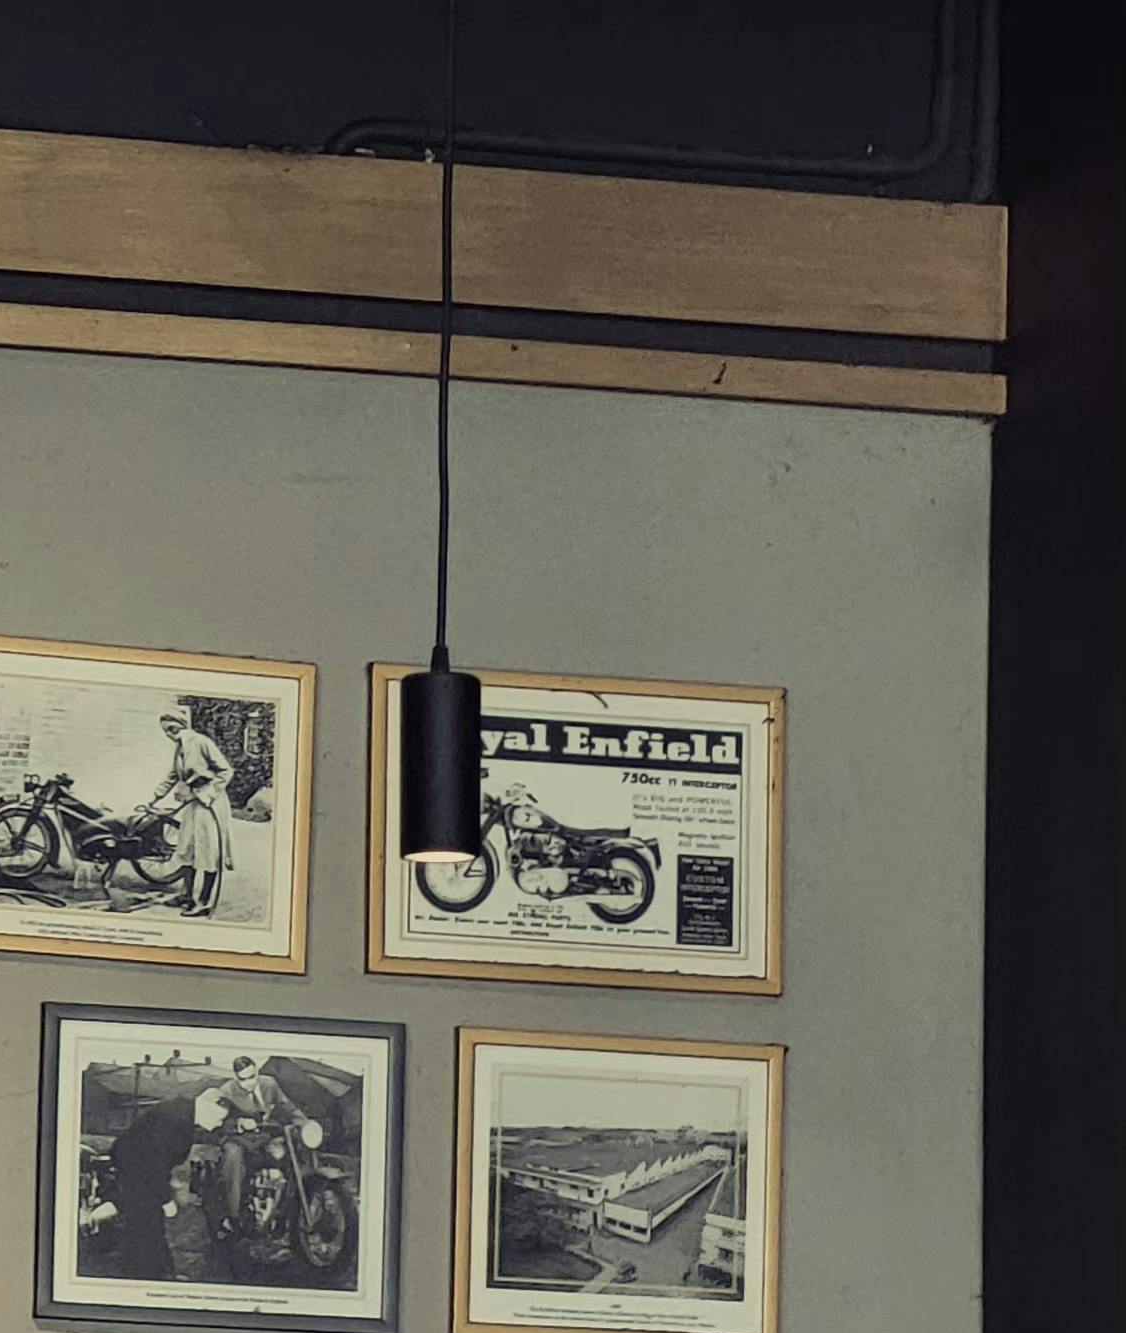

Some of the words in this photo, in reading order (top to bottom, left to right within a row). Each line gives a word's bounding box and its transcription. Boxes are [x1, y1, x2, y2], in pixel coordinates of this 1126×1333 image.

[480, 723, 551, 757] yal
[563, 725, 740, 764] Enfield
[621, 772, 661, 785] 750cc
